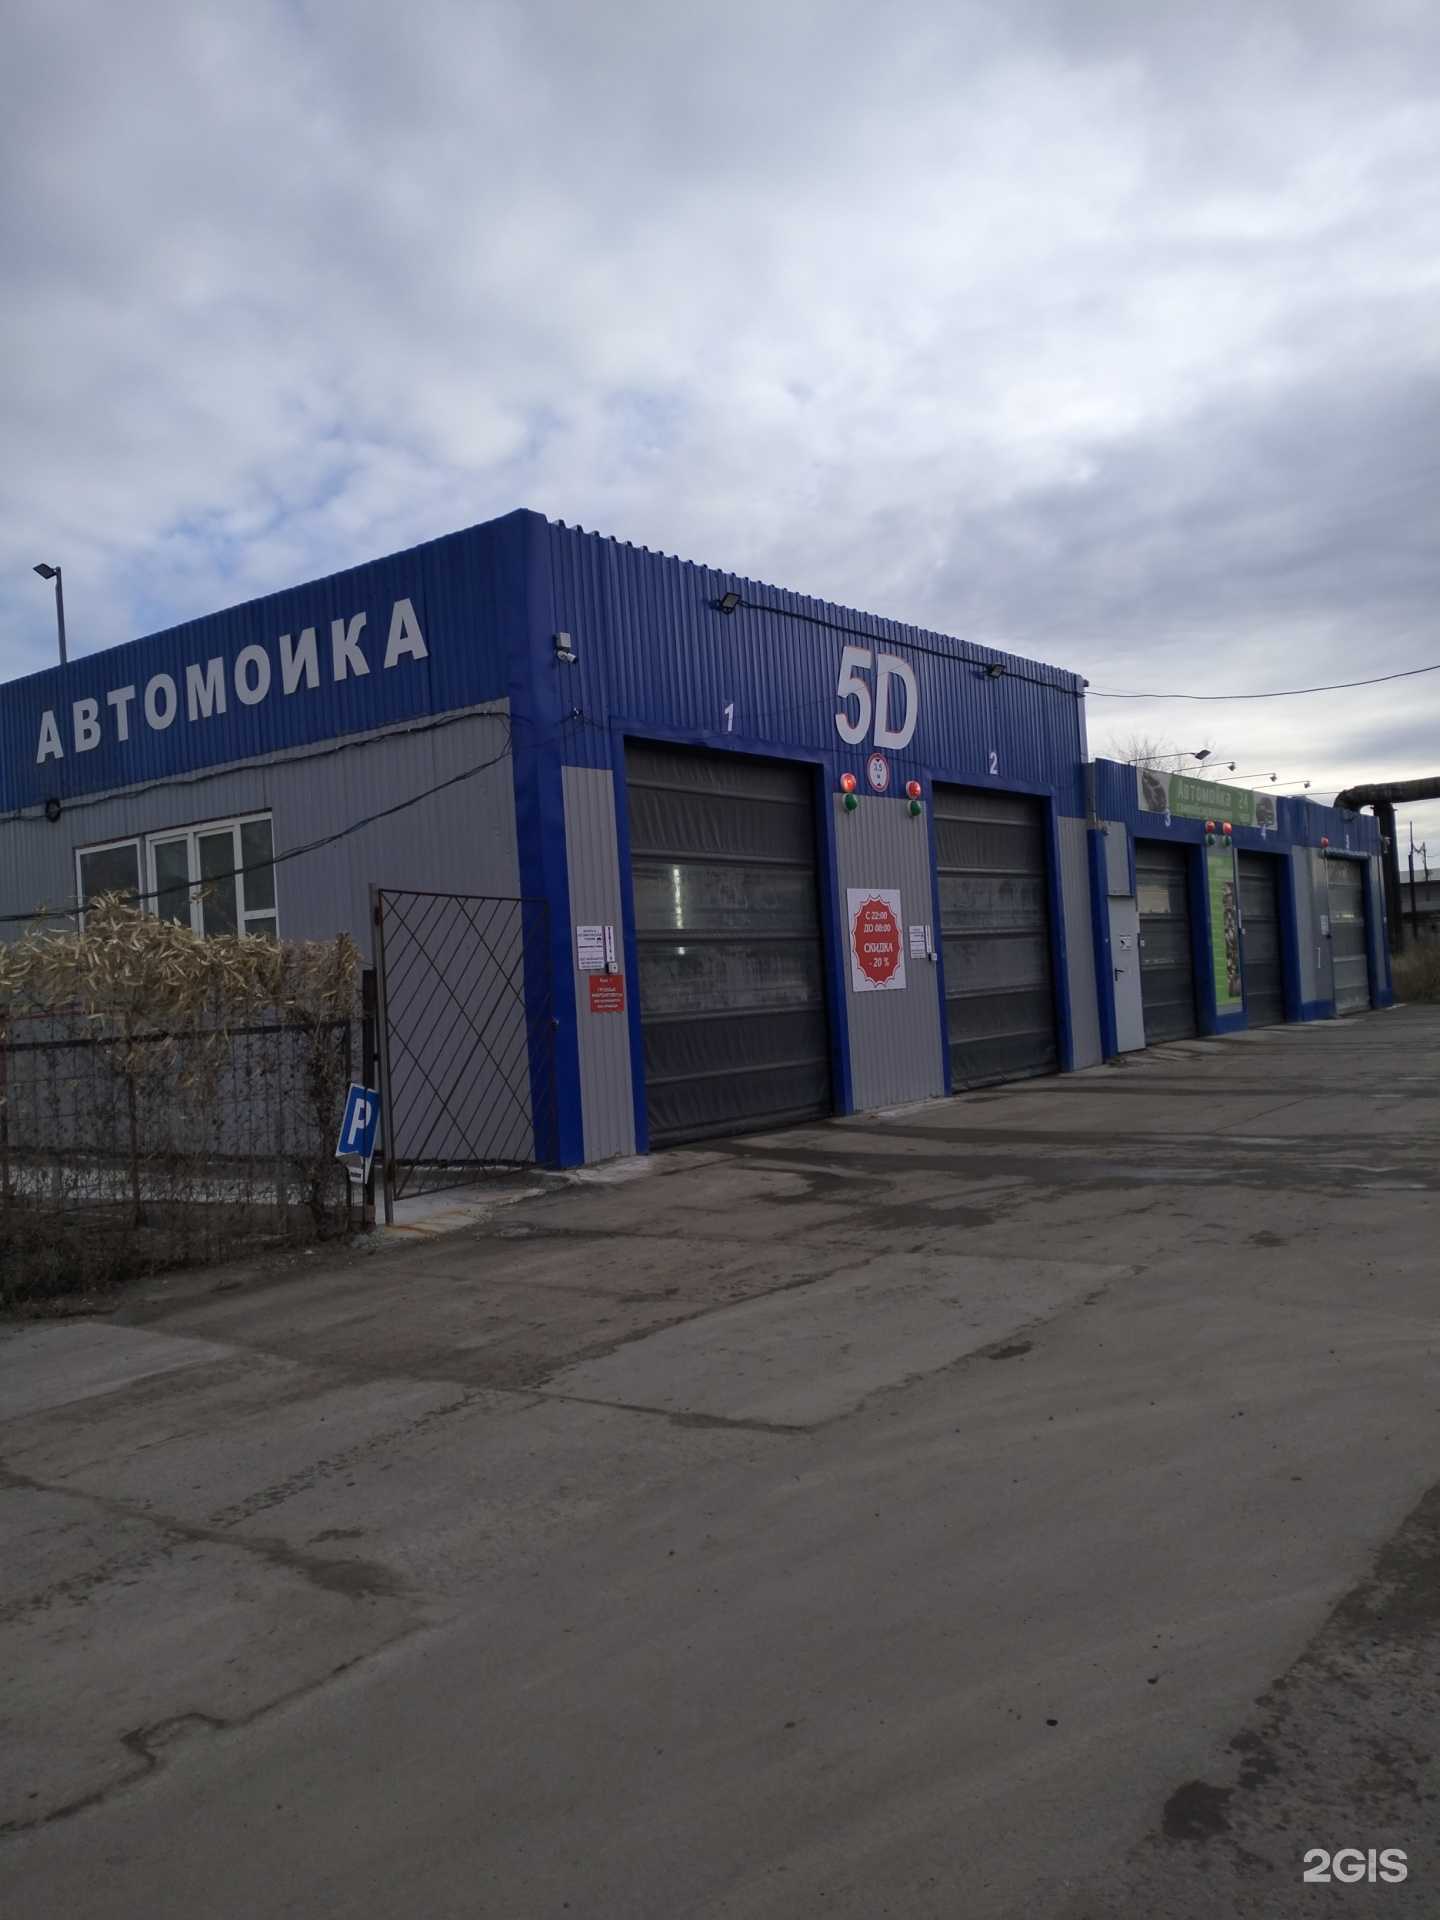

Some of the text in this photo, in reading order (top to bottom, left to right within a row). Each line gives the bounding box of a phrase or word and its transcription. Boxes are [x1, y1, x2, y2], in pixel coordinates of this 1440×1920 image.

[835, 645, 919, 750] 5D
[725, 703, 734, 731] 1
[990, 751, 998, 774] 2
[864, 924, 873, 933] ДО
[864, 943, 893, 952] СКИДКА
[347, 1098, 372, 1145] P
